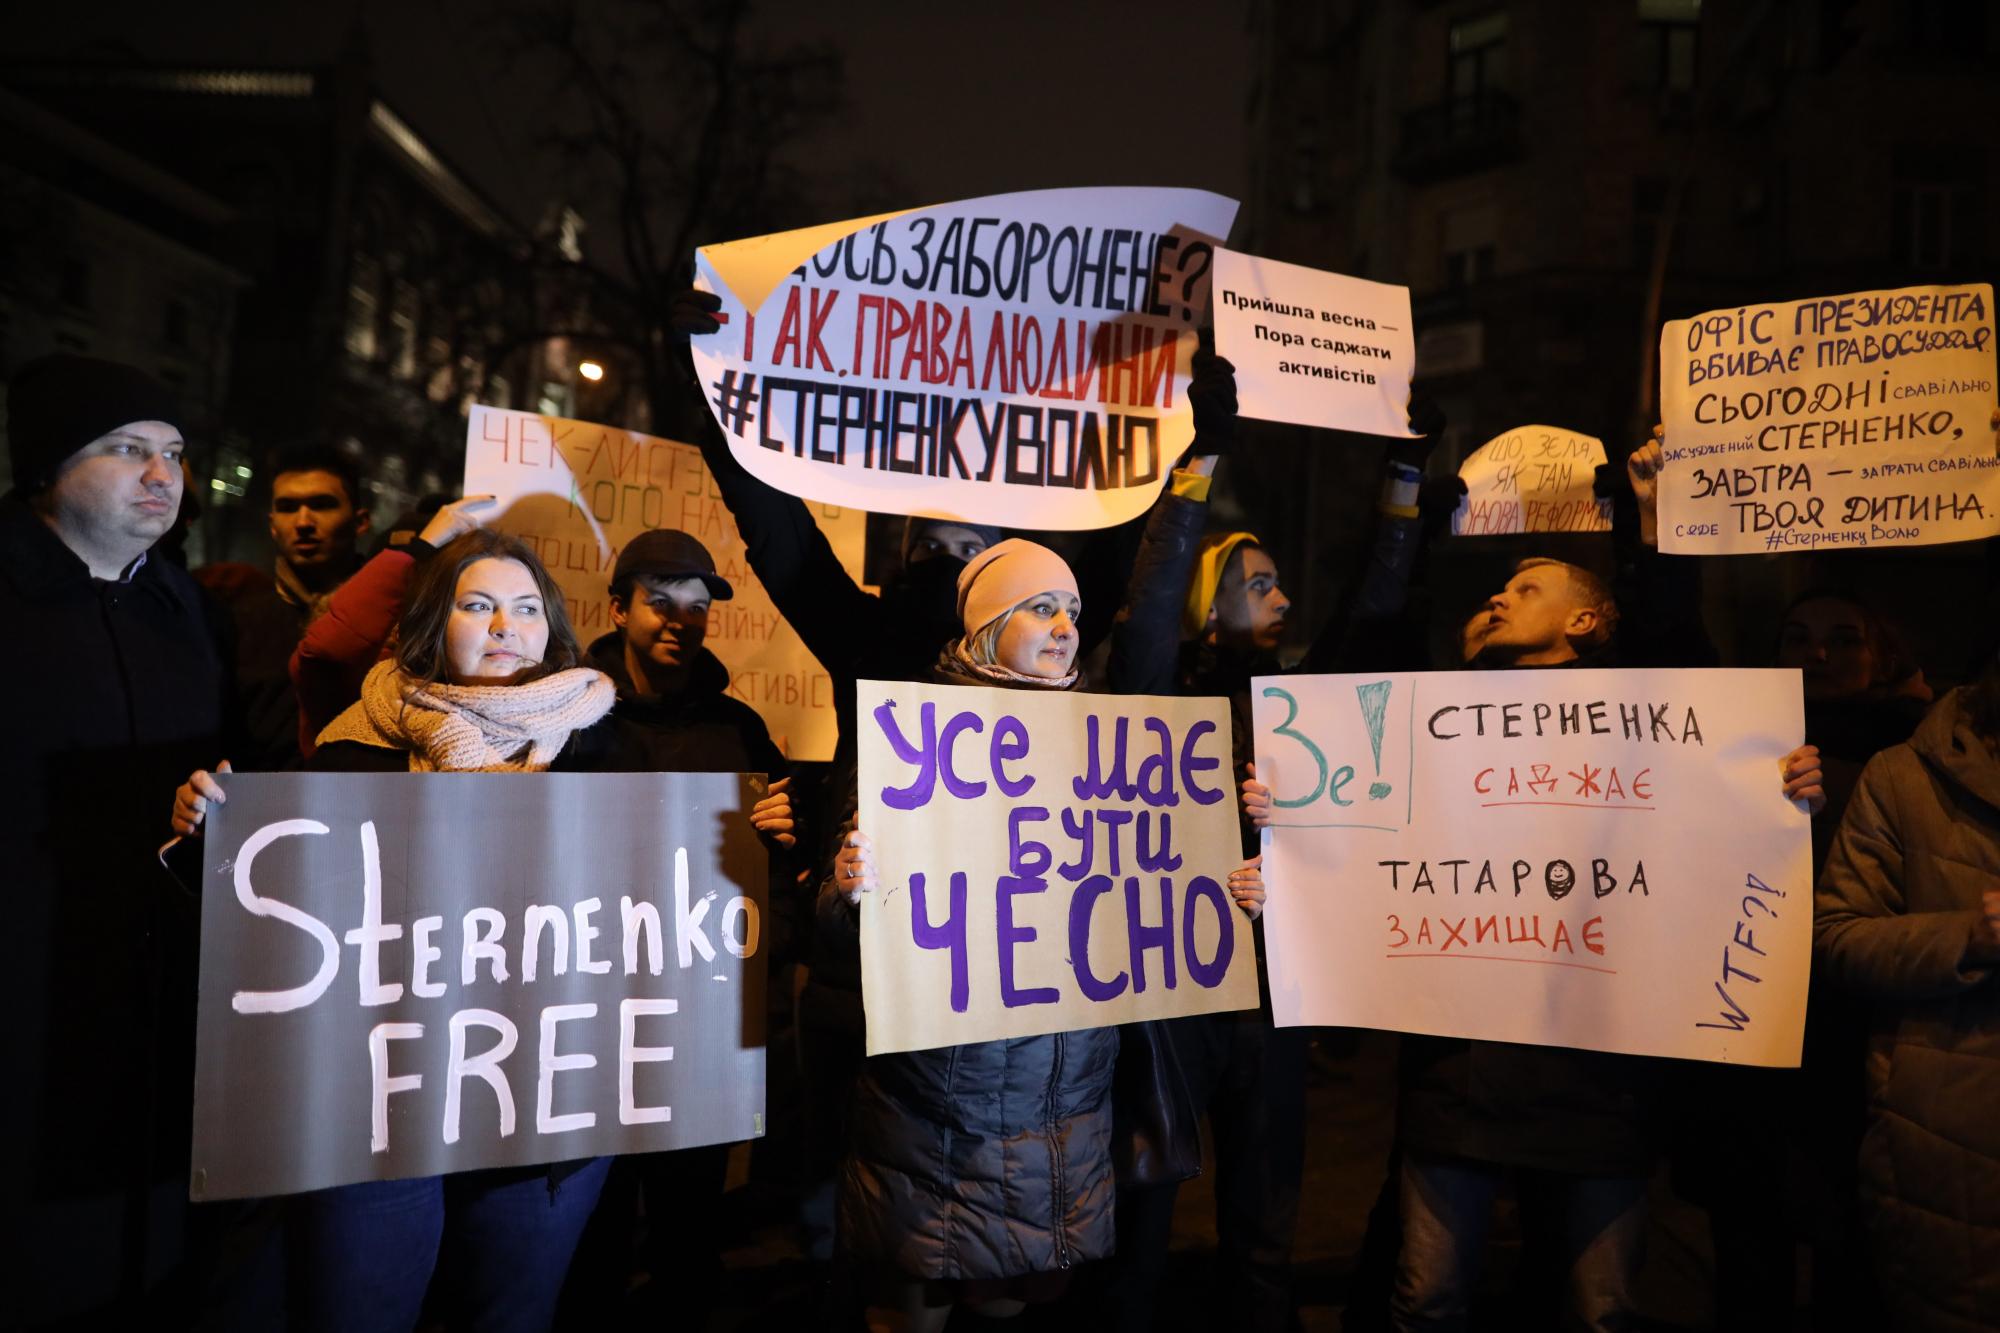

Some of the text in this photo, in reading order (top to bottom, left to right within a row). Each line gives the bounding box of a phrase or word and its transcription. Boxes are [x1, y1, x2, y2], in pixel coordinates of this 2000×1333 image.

[791, 217, 1213, 321] ОСЬ ЗАБОРОНЕНЕ?
[1222, 290, 1315, 320] Прийшла
[1321, 310, 1376, 331] весна
[1688, 292, 1985, 352] ОФІС ПРЕЗИДЕНТА
[854, 294, 976, 389] ПРАВА
[981, 309, 1179, 409] ЛЮДИНИ
[1254, 324, 1392, 361] Пора саджати
[1279, 360, 1377, 385] активістів
[1688, 346, 1805, 386] ВБИВАЄ
[1695, 371, 1992, 424] СЬОГОДНІ СВАВІЛЬНО
[1758, 411, 1964, 452] СТЕРНЕНКО,
[1491, 463, 1573, 495] ЯК ТАМ
[1691, 463, 1812, 499] ЗАВТРА
[1730, 497, 1825, 533] ТВОЯ
[1841, 493, 1994, 525] ДИТИНА.
[731, 669, 834, 709] КТИВІС
[1427, 701, 1704, 746] СТЕРНЕНКА
[1474, 763, 1655, 801] САДЖАЄ
[1378, 858, 1650, 900] ТАТАРОВА
[908, 871, 1235, 1013] ЧЕСНО
[1386, 914, 1606, 956] ЗАХИЩАЄ
[1695, 872, 1787, 1033] WTF?!
[368, 998, 679, 1154] FREE
